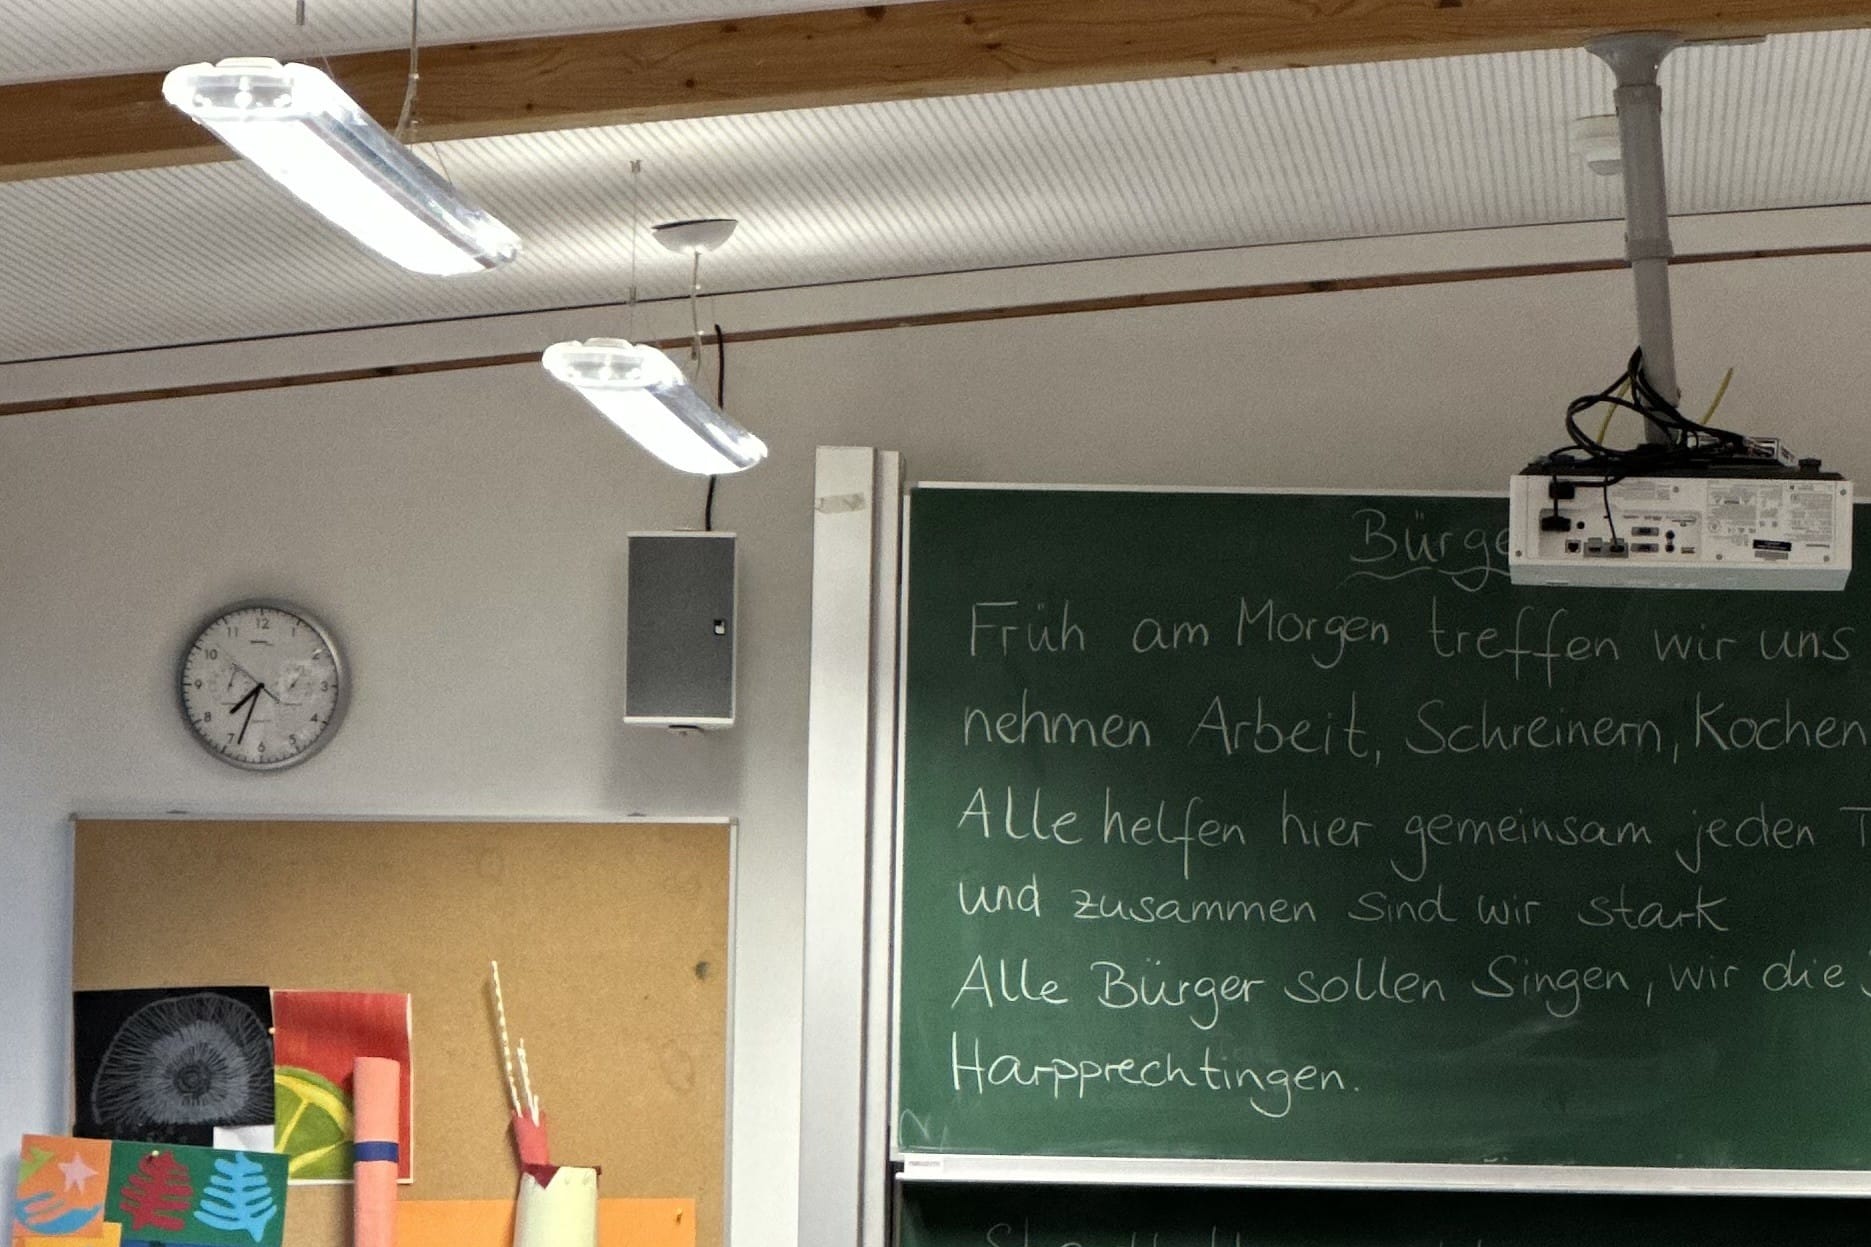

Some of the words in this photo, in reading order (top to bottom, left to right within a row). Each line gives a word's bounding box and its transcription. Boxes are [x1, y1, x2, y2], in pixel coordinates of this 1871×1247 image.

[255, 618, 270, 630] 12
[227, 626, 239, 638] 11
[970, 600, 1085, 656] Früh
[1132, 617, 1208, 653] am
[1238, 596, 1389, 669] Morgen
[1428, 596, 1619, 688] treffen
[1654, 624, 1738, 662] wir
[1761, 626, 1856, 662] uns
[204, 649, 218, 660] 10
[194, 679, 203, 690] 9
[320, 681, 329, 692] 3
[203, 711, 212, 722] 8
[309, 713, 319, 723] 4
[964, 688, 1151, 748] nehmen
[1188, 690, 1381, 768] Arbeit,
[1405, 699, 1679, 765] Schreinern,
[1695, 691, 1868, 751] Kochen
[227, 732, 235, 744] 7
[288, 734, 297, 745] 5
[257, 742, 266, 753] 6
[957, 786, 1083, 841] Alle
[1103, 785, 1247, 880] helfen
[1282, 789, 1374, 848] hier
[1389, 807, 1652, 882] gemeinsam
[1675, 801, 1815, 874] jeden
[958, 872, 1041, 918] und
[1070, 888, 1317, 923] zusammen
[1347, 883, 1458, 924] sind
[1477, 893, 1542, 926] wir
[1577, 883, 1729, 932] stark
[951, 954, 1069, 1009] Alle
[1090, 956, 1265, 1030] Bürger
[1668, 954, 1739, 991] wir
[1762, 948, 1846, 992] die
[951, 1031, 1360, 1118] Harpprechtingen.
